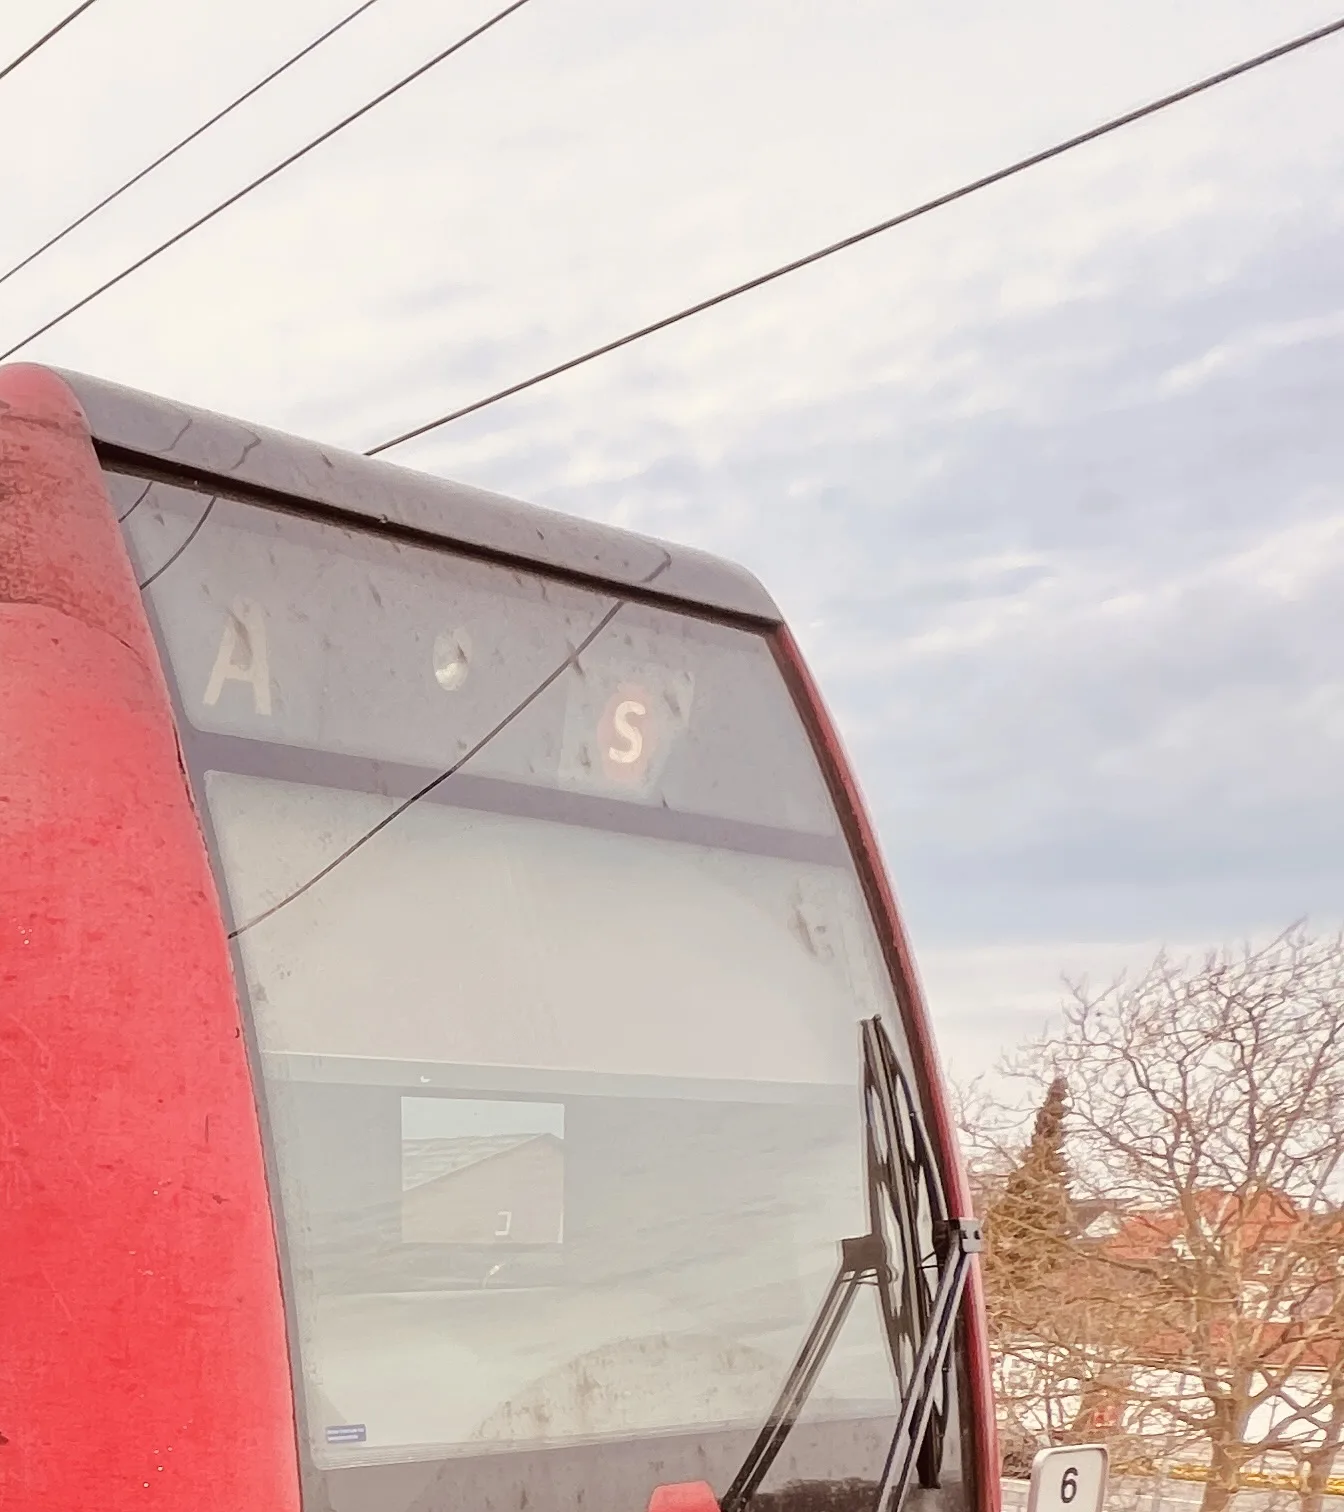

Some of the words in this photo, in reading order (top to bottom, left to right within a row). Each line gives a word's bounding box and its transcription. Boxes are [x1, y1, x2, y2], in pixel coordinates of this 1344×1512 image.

[203, 602, 272, 716] A
[609, 700, 647, 764] S
[1060, 1467, 1079, 1504] 6
